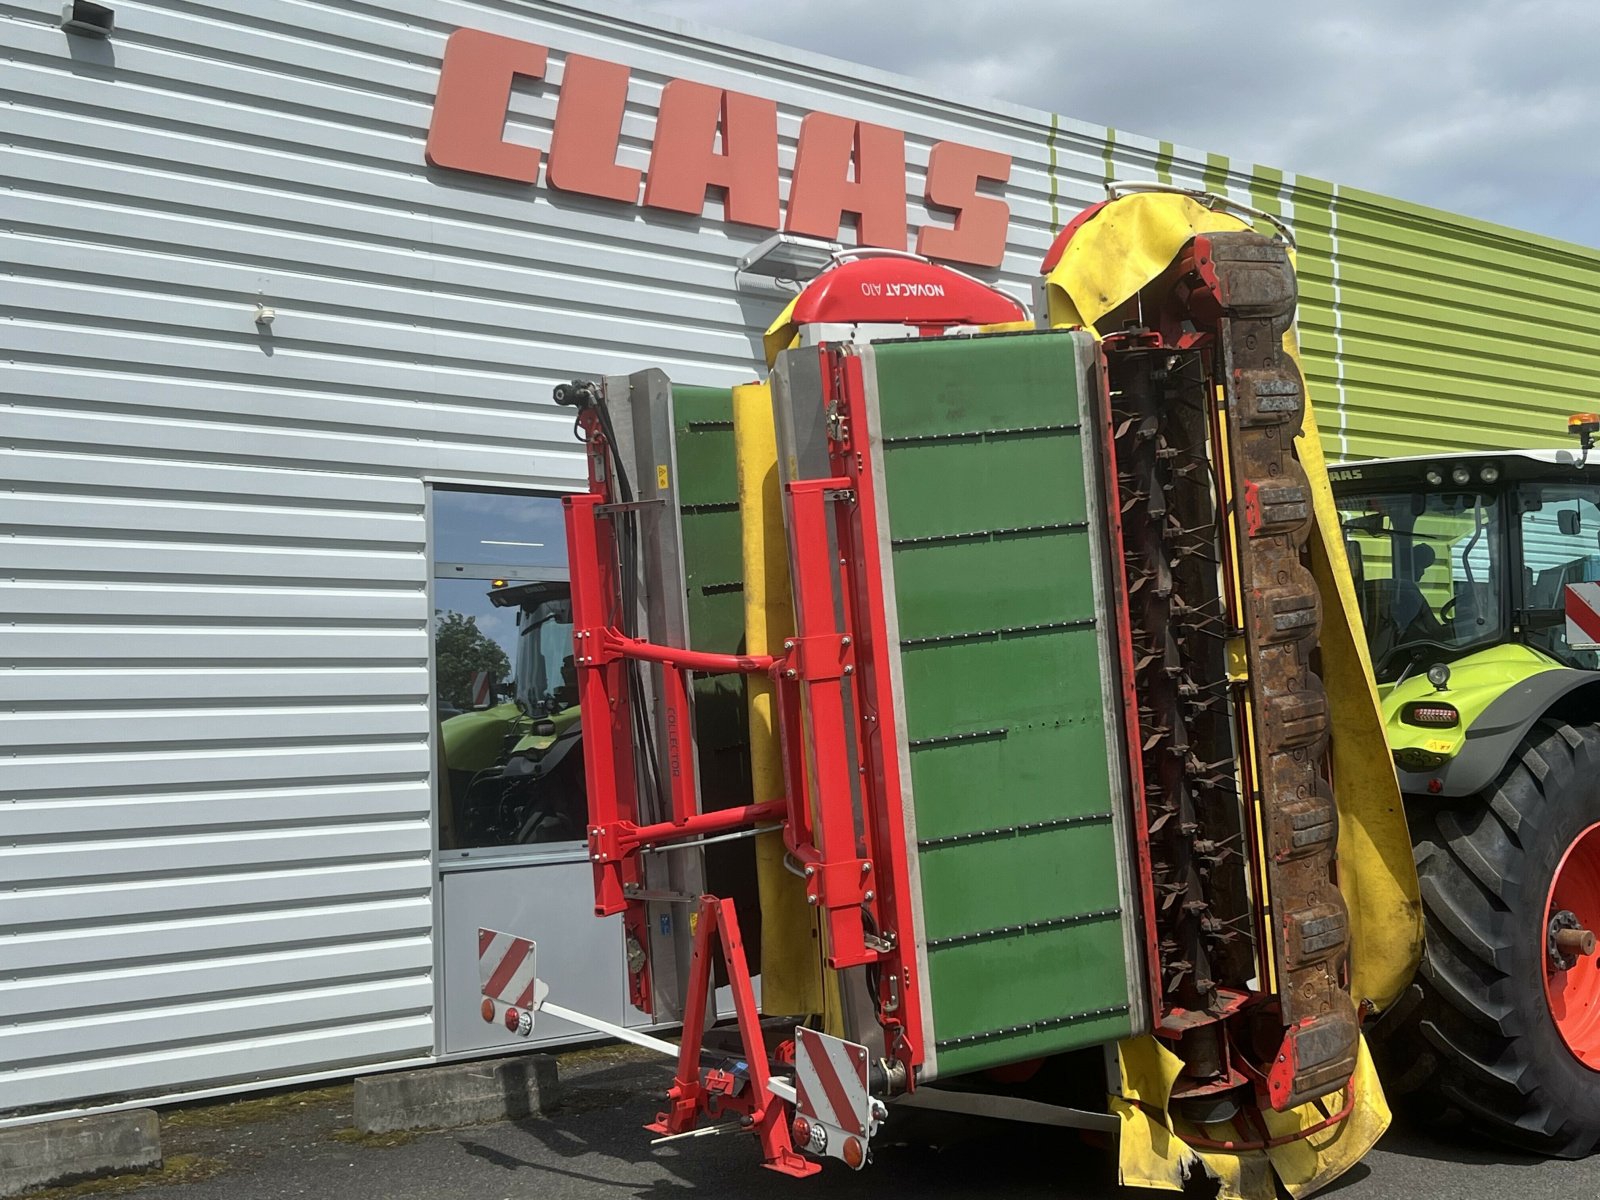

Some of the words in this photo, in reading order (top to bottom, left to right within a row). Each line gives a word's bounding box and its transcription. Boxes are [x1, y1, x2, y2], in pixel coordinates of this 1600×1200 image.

[425, 27, 1012, 268] CLAAS
[886, 283, 945, 297] NOVACAT
[1329, 469, 1363, 482] AAS
[667, 706, 680, 778] COLLECTOR
